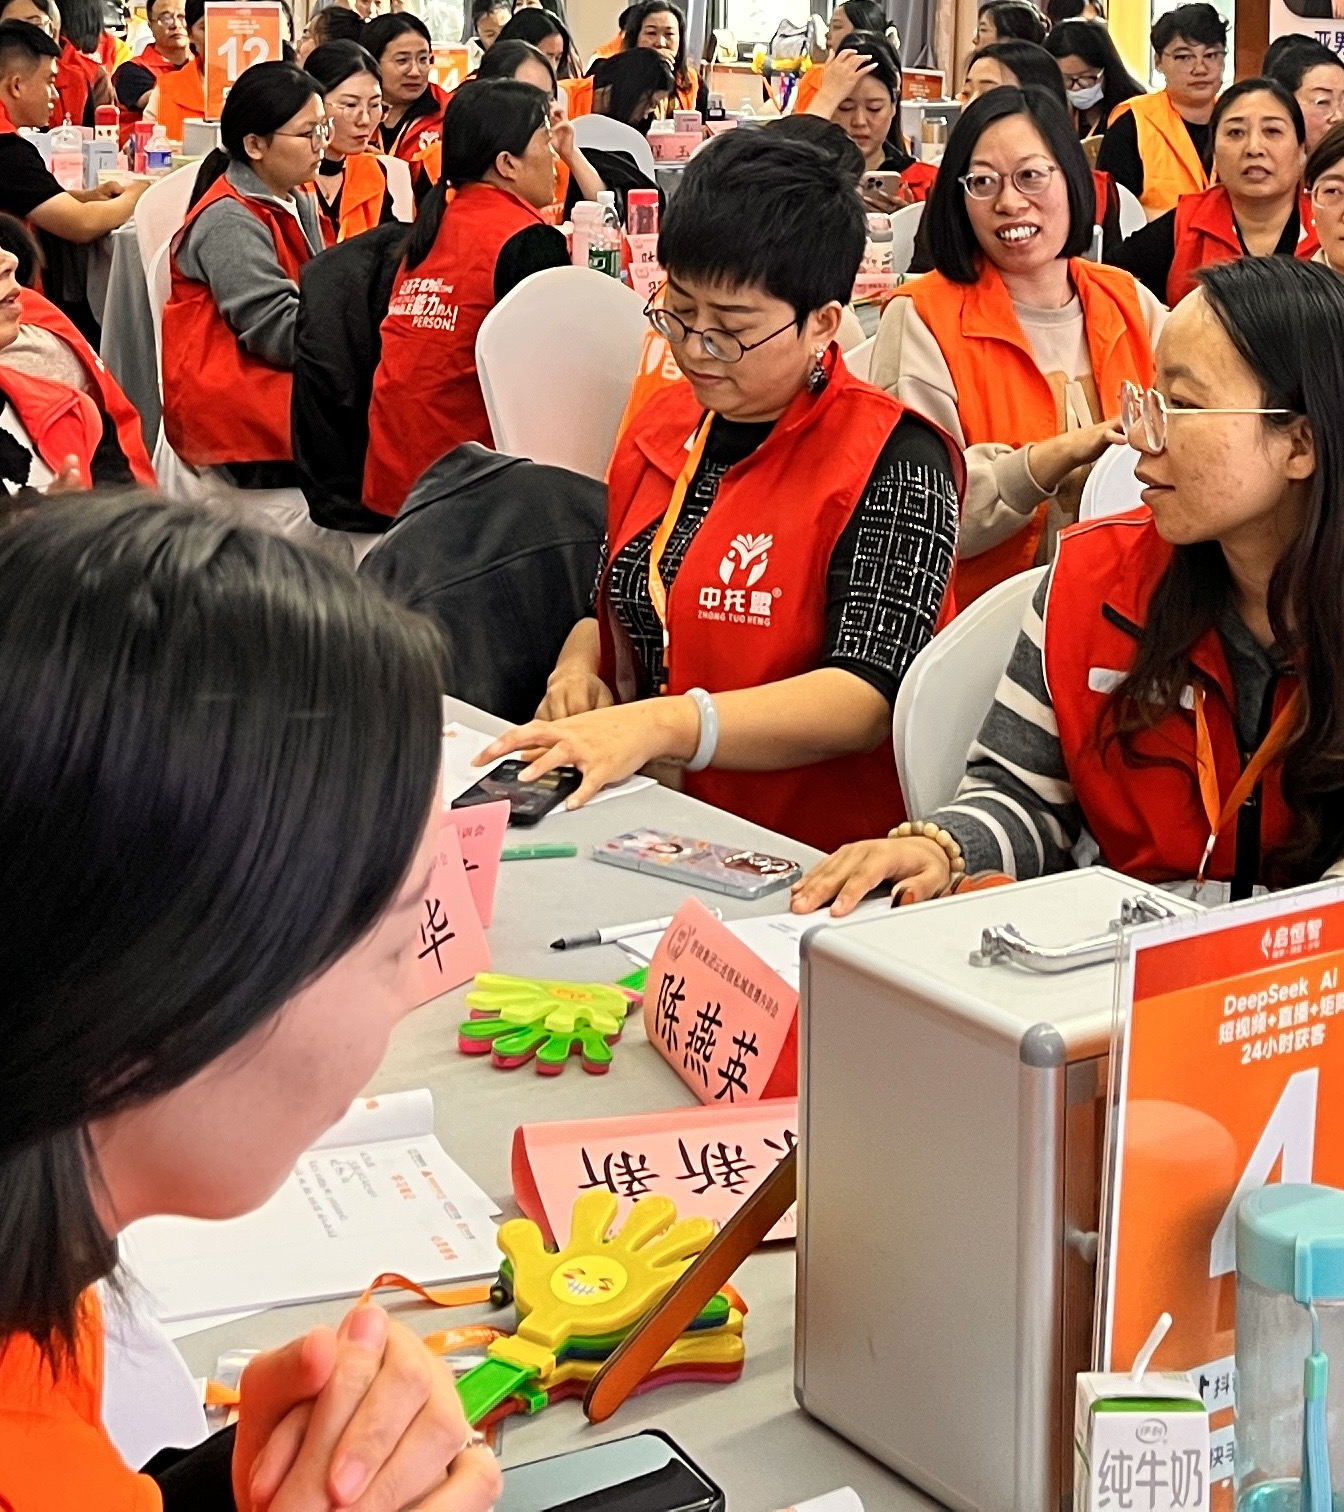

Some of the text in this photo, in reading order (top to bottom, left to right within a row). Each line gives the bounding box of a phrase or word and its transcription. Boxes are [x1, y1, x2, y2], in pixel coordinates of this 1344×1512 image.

[217, 36, 270, 82] 12
[698, 586, 773, 616] 中托盟
[1223, 976, 1309, 1017] DeepSeek
[655, 971, 761, 1104] 陈燕英
[1241, 1022, 1327, 1066] 24小时获客
[1098, 1448, 1203, 1509] 纯牛奶
